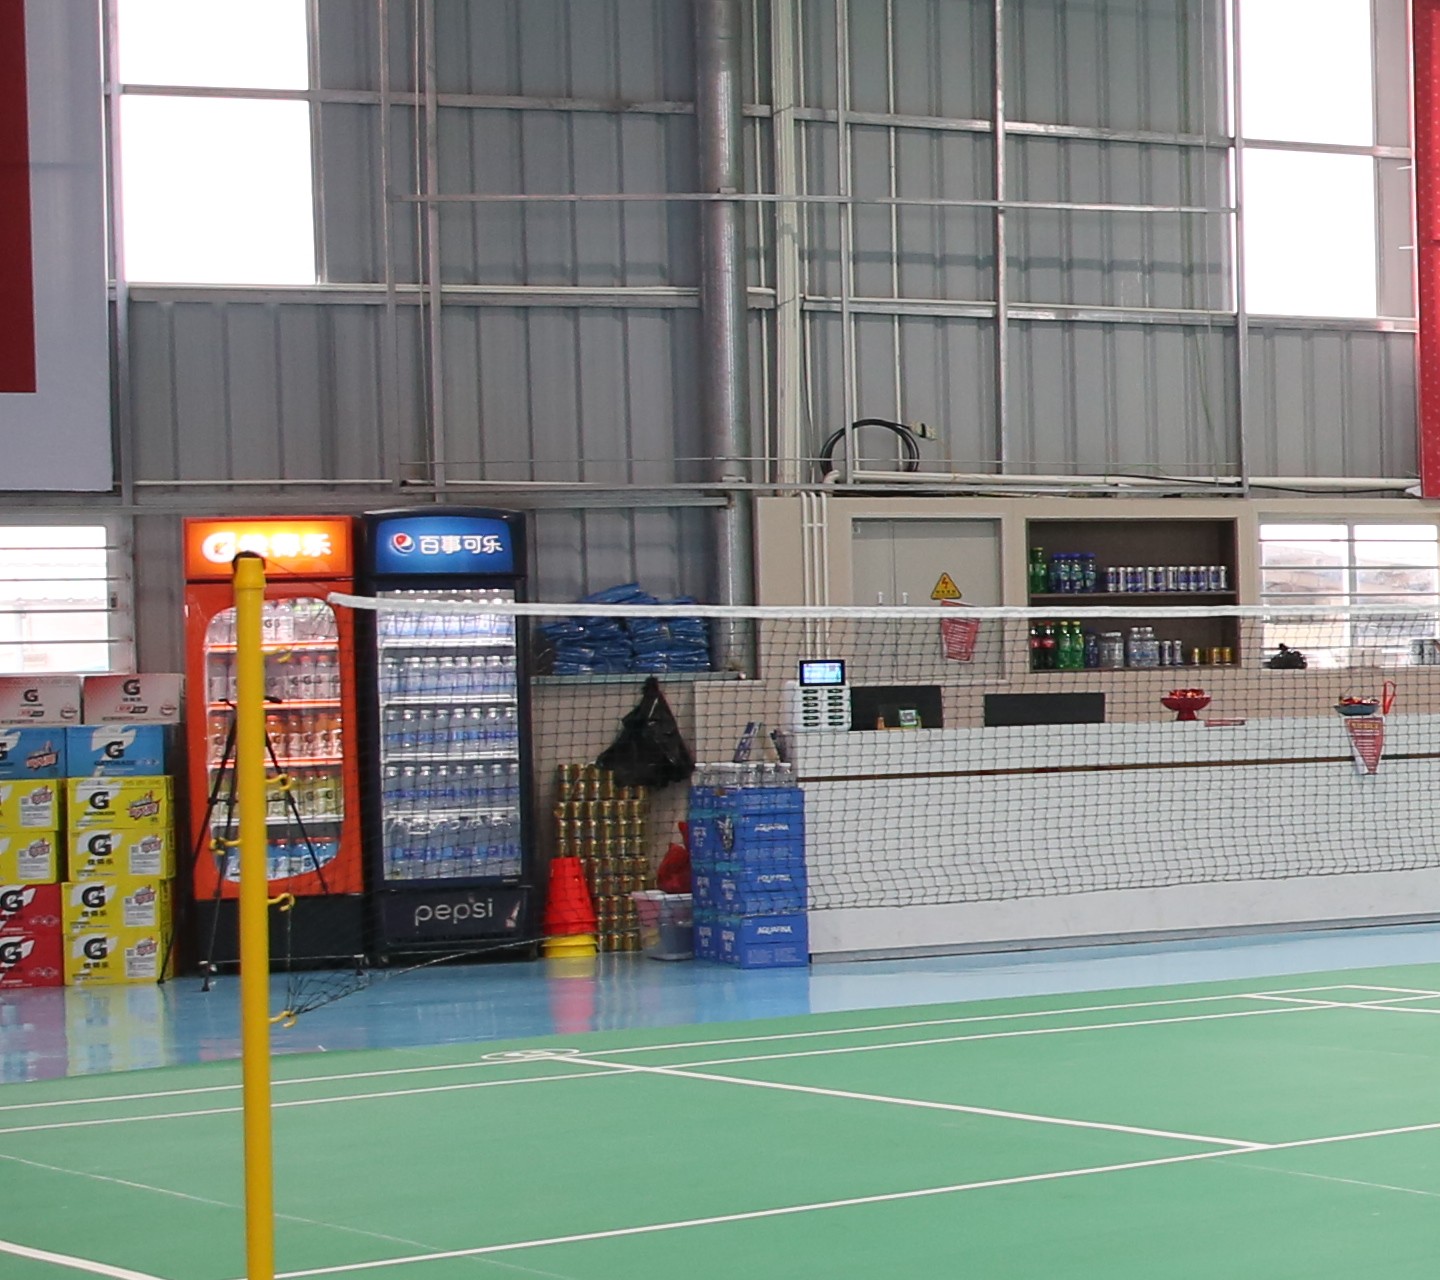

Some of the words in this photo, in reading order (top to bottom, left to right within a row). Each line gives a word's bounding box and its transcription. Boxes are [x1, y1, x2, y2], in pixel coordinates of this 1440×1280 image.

[419, 534, 503, 555] 百事可乐
[105, 740, 124, 759] G
[90, 791, 109, 810] G
[88, 834, 112, 856] G
[82, 886, 106, 909] G
[414, 898, 493, 926] pepsi
[84, 937, 108, 960] G
